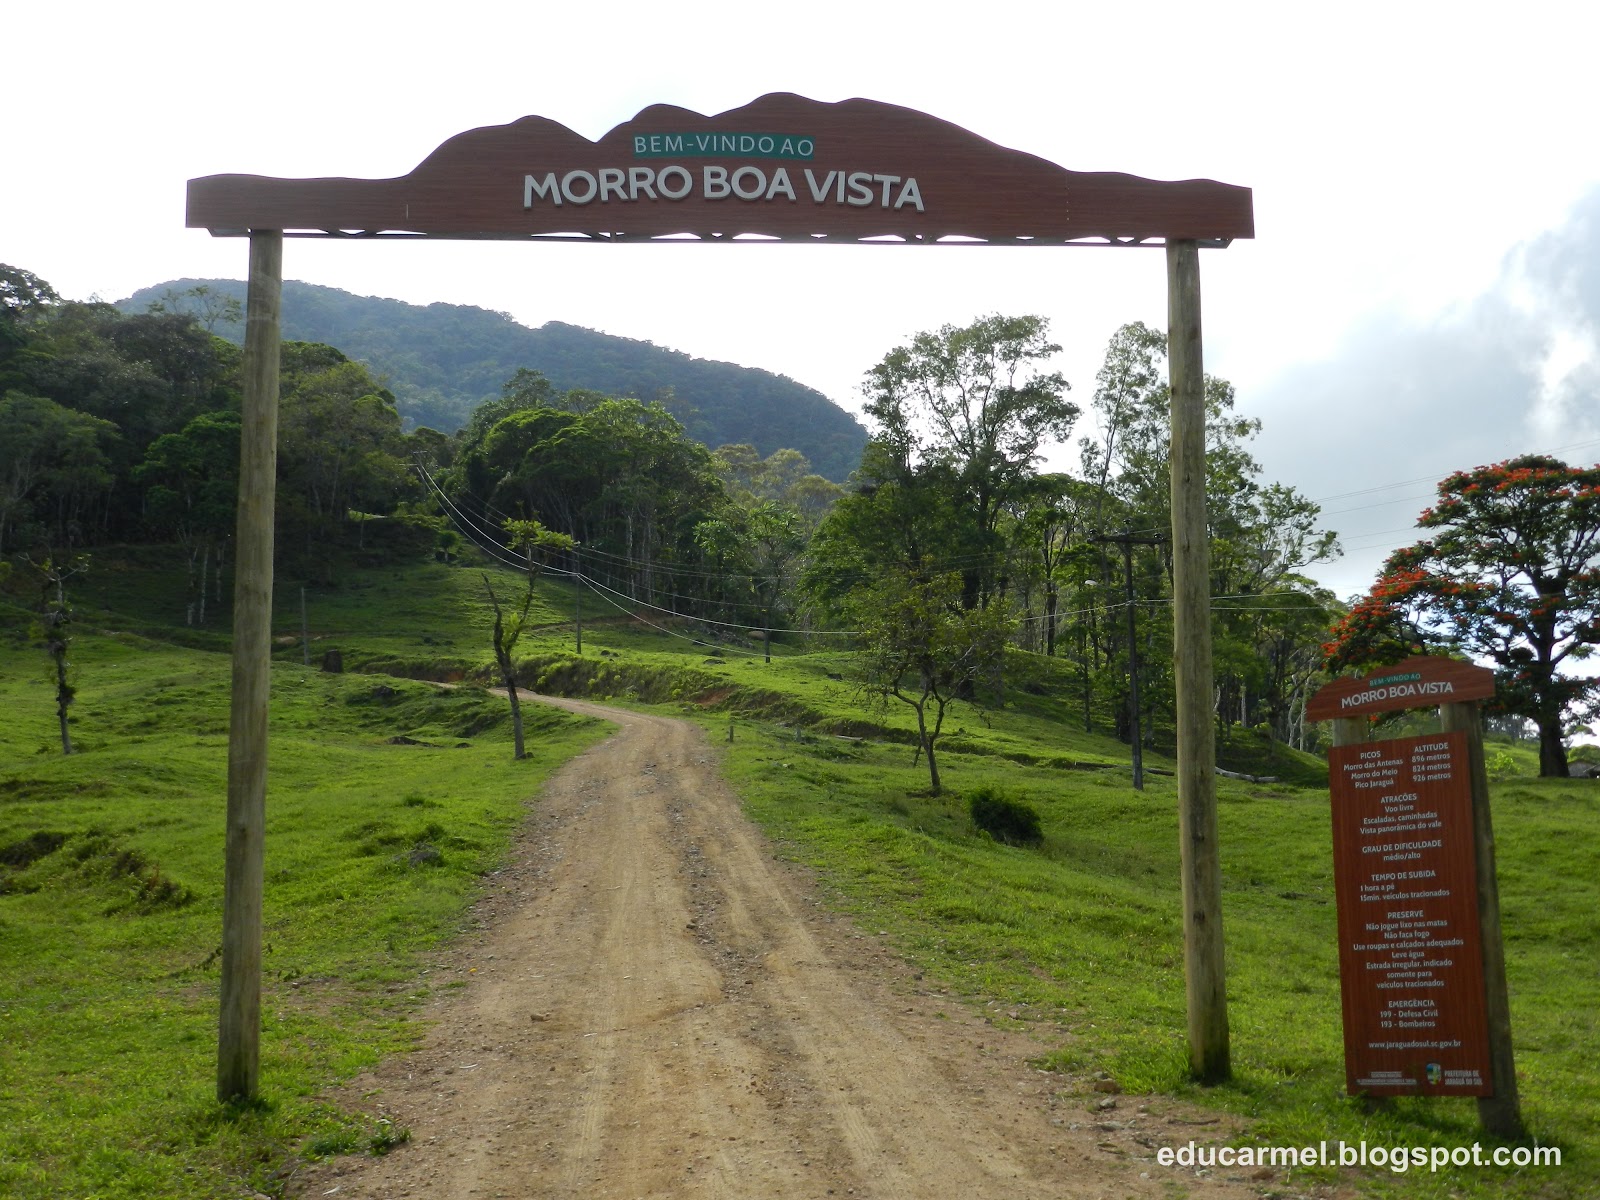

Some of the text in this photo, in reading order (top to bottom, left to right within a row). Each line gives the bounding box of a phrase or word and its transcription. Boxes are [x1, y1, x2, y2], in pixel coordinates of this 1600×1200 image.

[634, 135, 814, 156] BEM-VINDO AO
[523, 166, 925, 213] MORRO BOA VISTA
[1370, 674, 1409, 686] BEM-VINDO
[1342, 682, 1453, 708] MORRO BOA VISTA
[1414, 742, 1448, 752] ALTITUDE
[1360, 751, 1380, 759] PICOS
[1344, 762, 1362, 770] Morro
[1377, 759, 1403, 767] Antenas
[1370, 778, 1394, 787] Jaraguá
[1381, 793, 1417, 803] ATRAÇÕES
[1398, 812, 1437, 821] caminhadas
[1378, 823, 1416, 834] panorâmica
[1362, 845, 1381, 853] GRAU
[1395, 840, 1442, 850] DIFICULDADE
[1383, 852, 1420, 861] médio/alto
[1372, 873, 1395, 881] TEMPO
[1409, 870, 1436, 878] SUBIDA
[1386, 883, 1394, 891] pé
[1383, 891, 1409, 900] veículos
[1411, 889, 1449, 898] tracionados
[1388, 910, 1423, 919] PRESERVE
[1380, 921, 1399, 931] jogue
[1414, 930, 1430, 938] fogo
[1367, 943, 1389, 951] roupas
[1426, 938, 1463, 948] adequados
[1409, 951, 1424, 959] água
[1389, 998, 1434, 1008] EMERGÊNCIA
[1369, 1040, 1461, 1049] www.jaraguadosul.sc.gov.br
